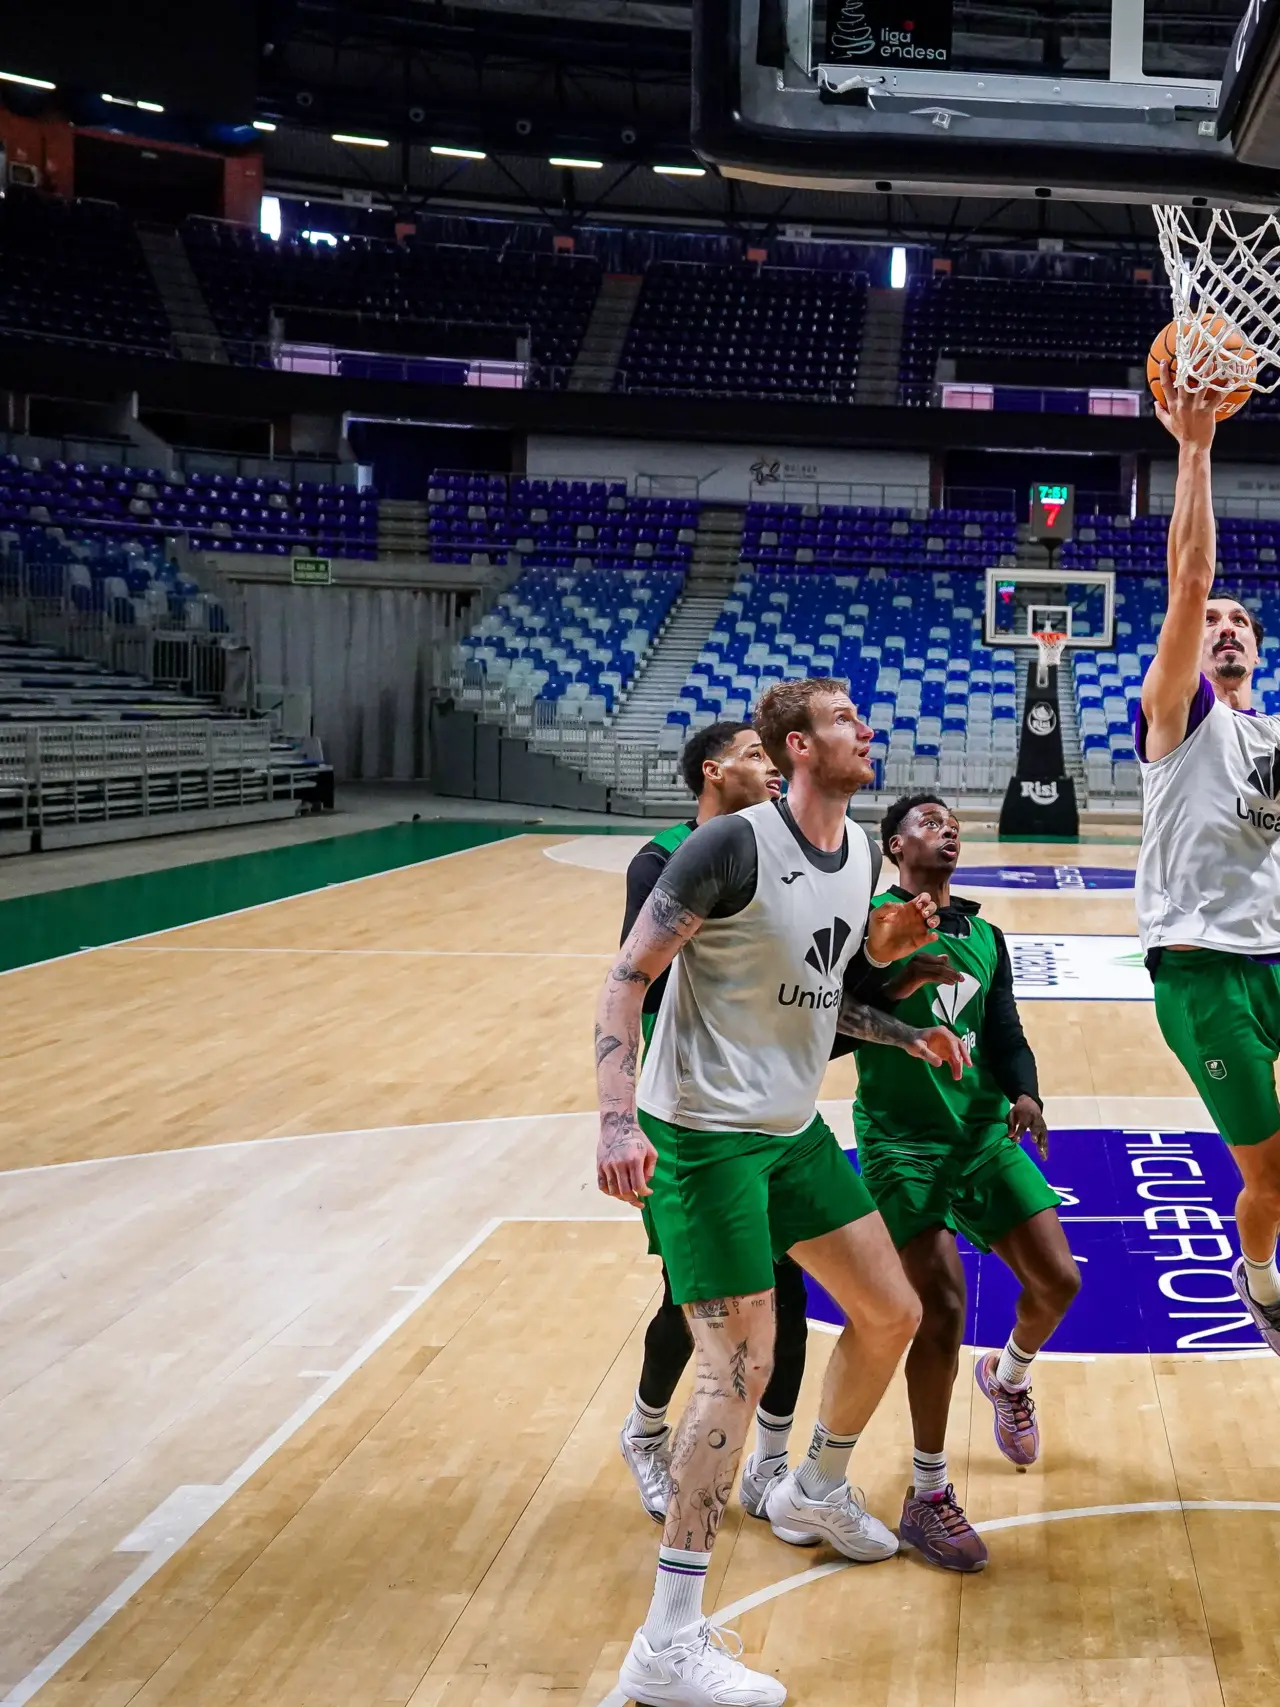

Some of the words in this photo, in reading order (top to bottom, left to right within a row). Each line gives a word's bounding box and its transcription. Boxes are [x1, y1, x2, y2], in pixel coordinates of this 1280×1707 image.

[881, 27, 911, 45] liga
[880, 44, 947, 60] endesa
[1043, 503, 1061, 527] 7
[1020, 781, 1060, 805] Risi
[778, 983, 842, 1010] Unica
